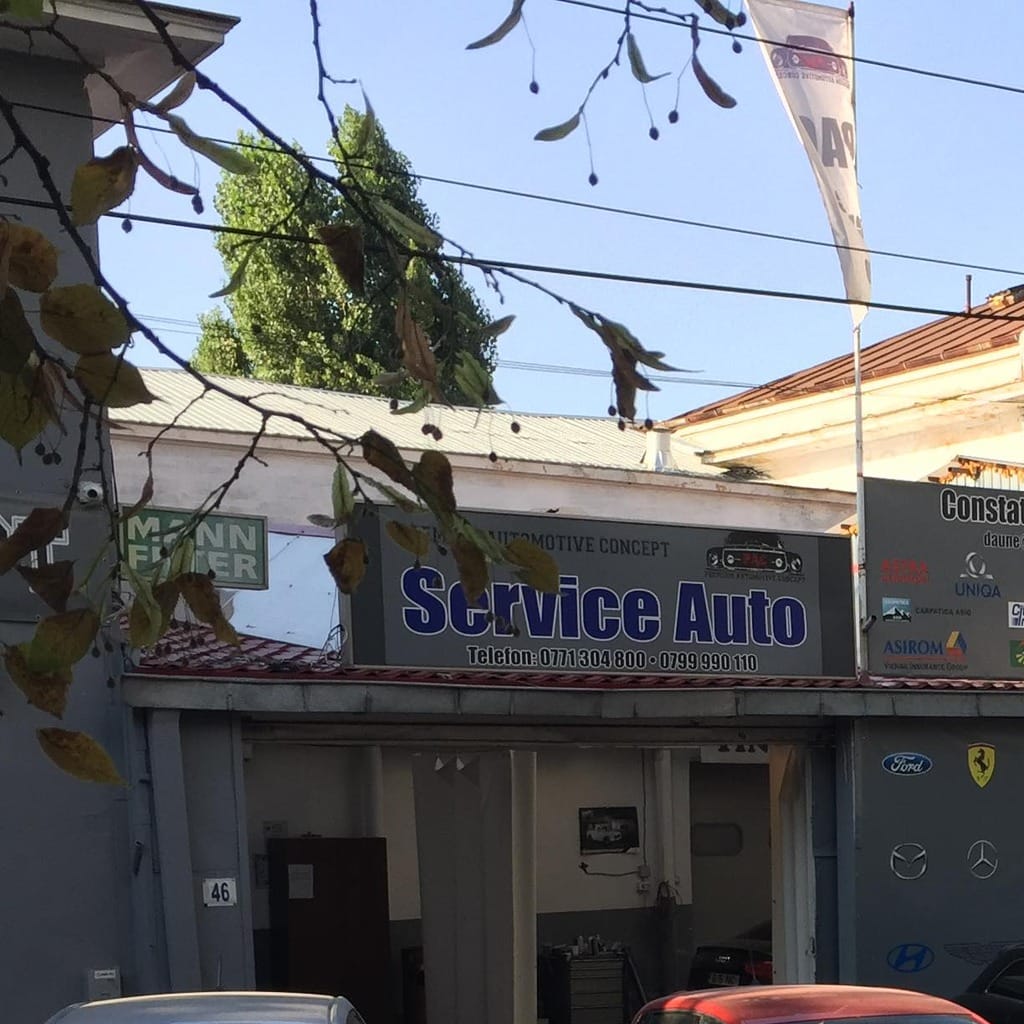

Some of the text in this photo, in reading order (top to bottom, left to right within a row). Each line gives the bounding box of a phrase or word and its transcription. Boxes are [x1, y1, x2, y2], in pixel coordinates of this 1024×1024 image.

[128, 515, 257, 551] MANN
[600, 538, 670, 557] CONCEPT
[128, 544, 258, 579] FIER
[955, 583, 1001, 598] UNIQA
[401, 565, 808, 648] Service Auto
[884, 640, 943, 655] ASIROM
[468, 646, 758, 671] Telefon: 0771 304 800 0799 990 110
[890, 753, 925, 774] Ford
[211, 882, 231, 902] 46
